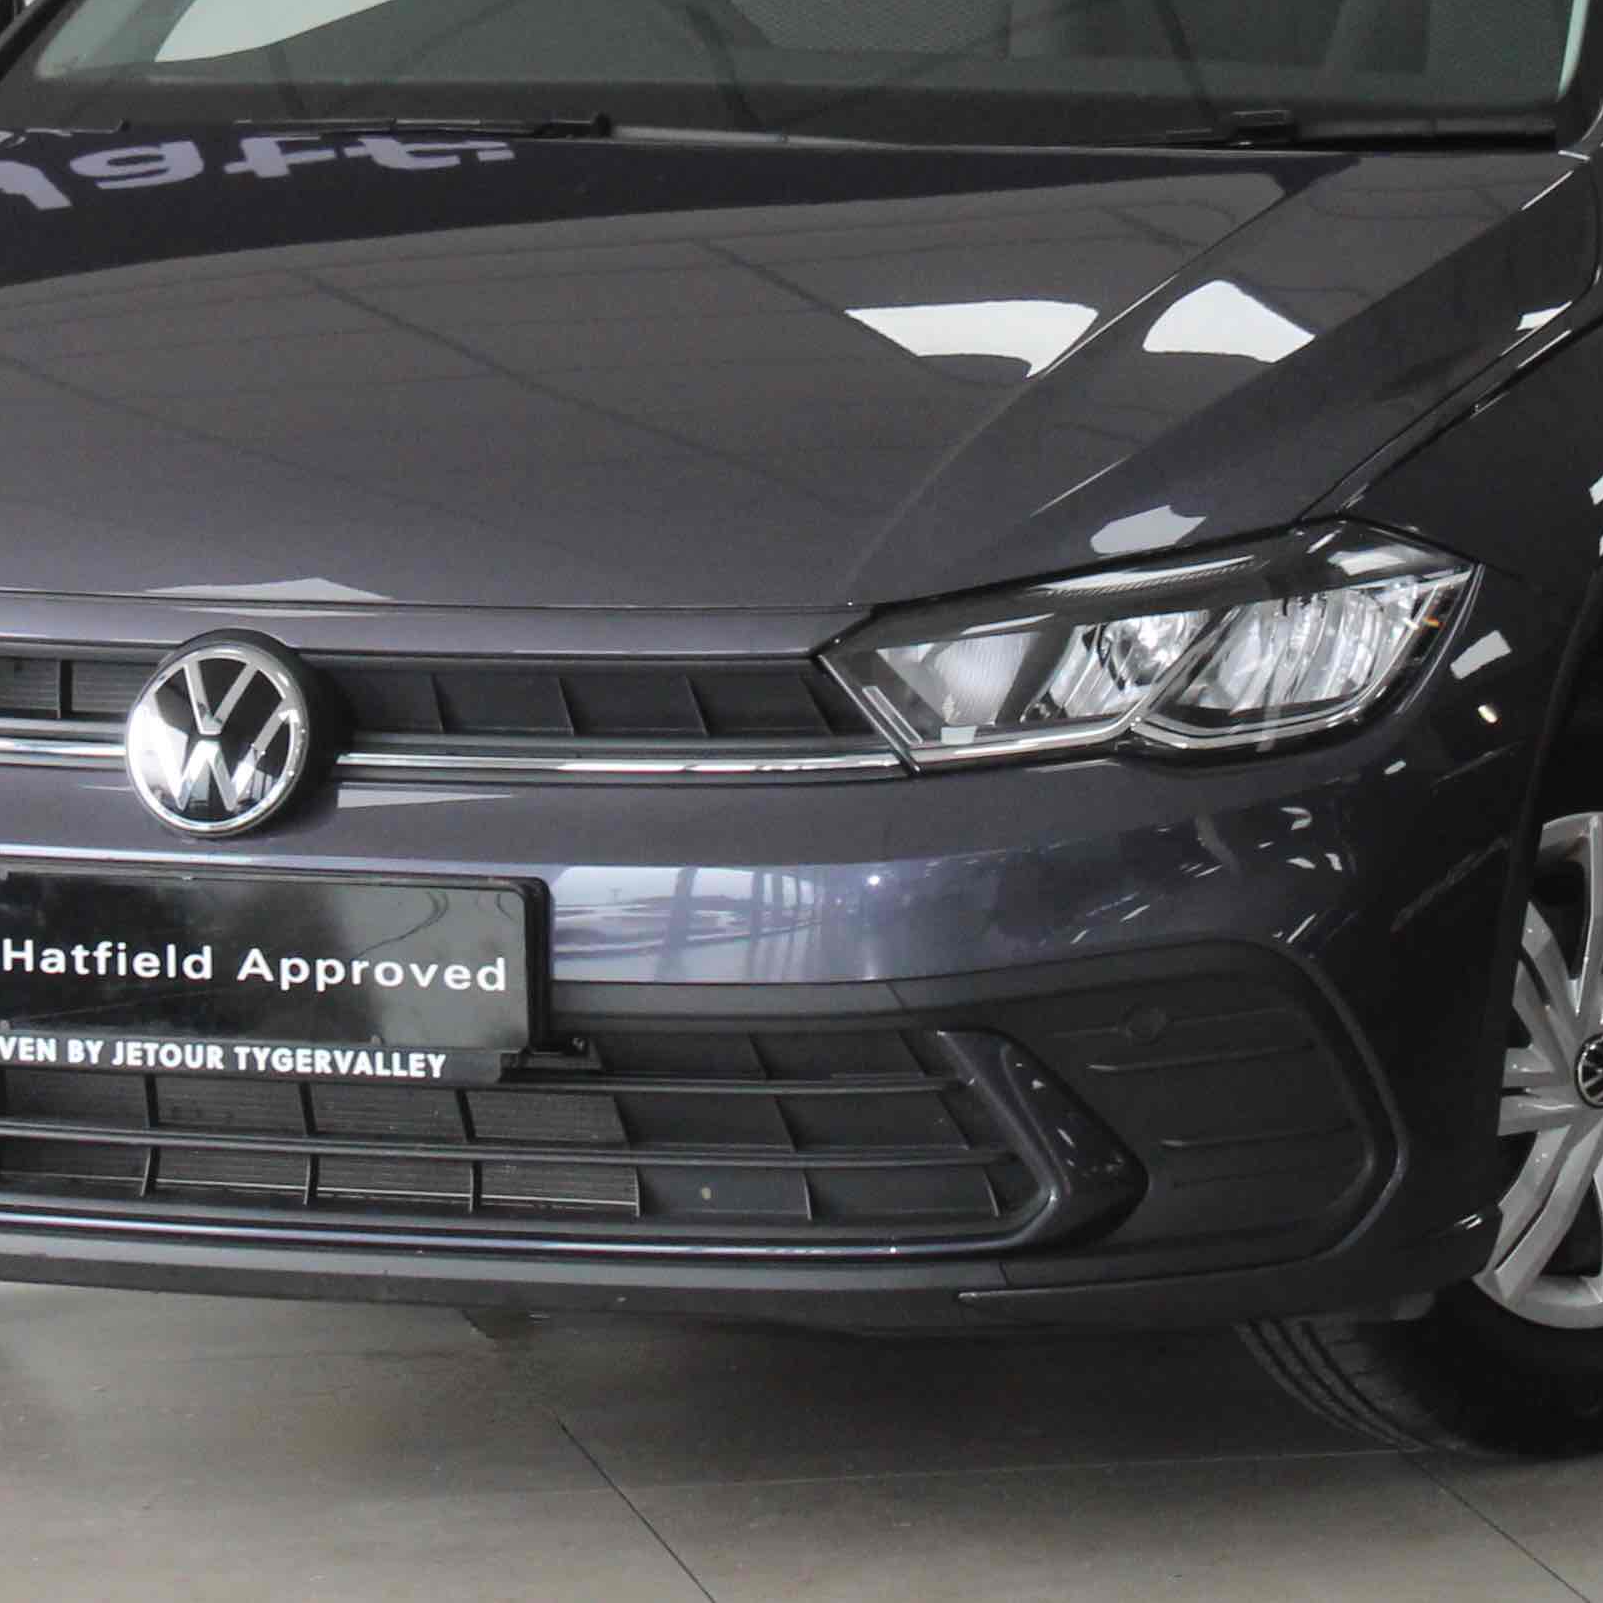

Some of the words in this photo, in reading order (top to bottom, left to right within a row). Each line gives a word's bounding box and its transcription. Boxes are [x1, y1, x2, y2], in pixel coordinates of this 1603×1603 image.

[136, 651, 303, 825] VW
[2, 938, 213, 981] Hatfield
[236, 947, 508, 993] Approved
[67, 1038, 105, 1065] BY
[111, 1040, 225, 1070] JETOUR
[233, 1045, 447, 1079] TYGERVALLEY
